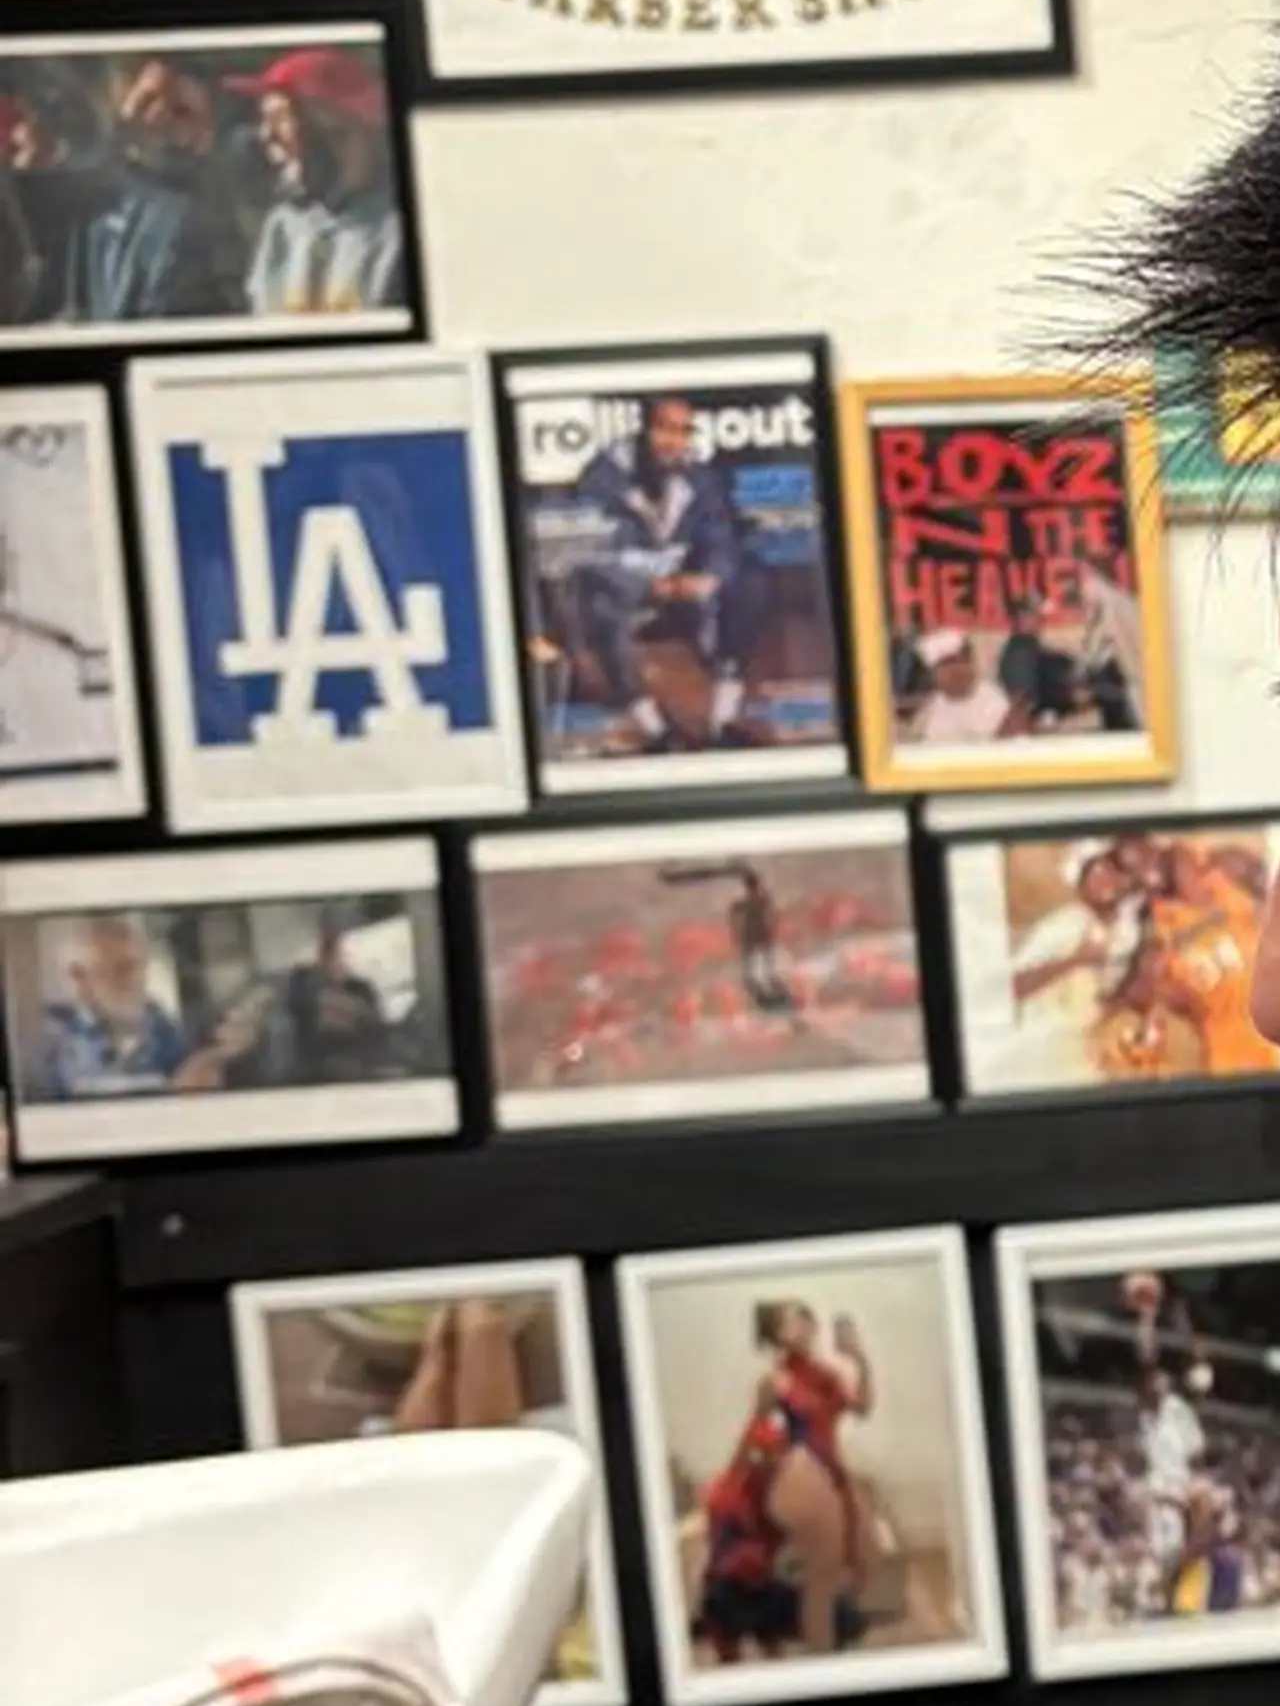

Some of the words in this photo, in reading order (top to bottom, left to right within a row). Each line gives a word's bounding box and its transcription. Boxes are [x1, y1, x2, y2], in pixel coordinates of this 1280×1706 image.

[878, 424, 1126, 509] BOYZ
[1025, 506, 1117, 558] THE
[200, 438, 448, 742] LA
